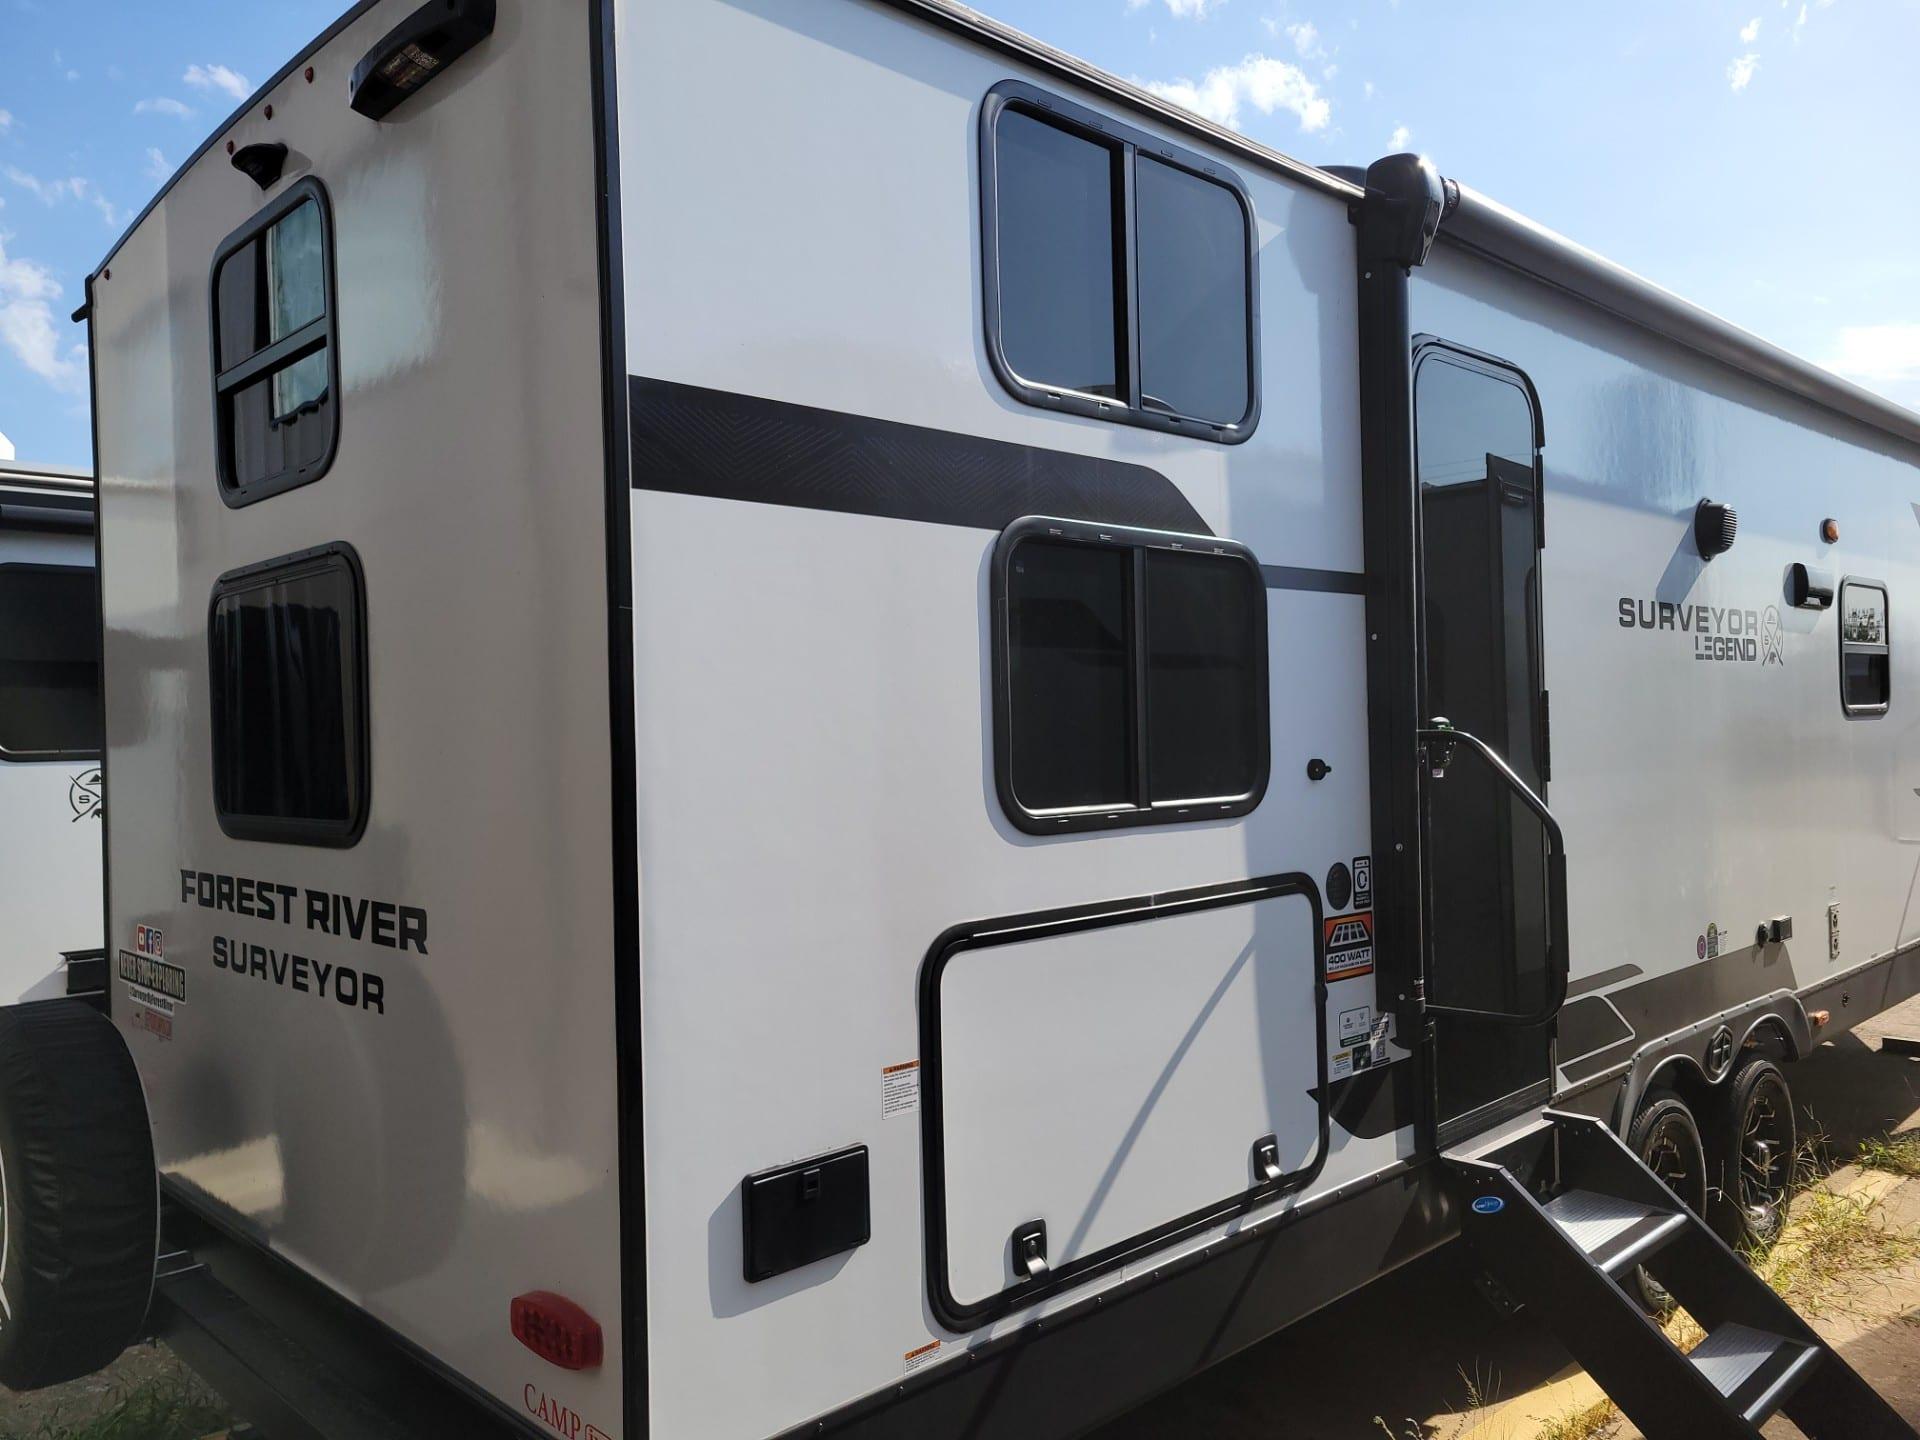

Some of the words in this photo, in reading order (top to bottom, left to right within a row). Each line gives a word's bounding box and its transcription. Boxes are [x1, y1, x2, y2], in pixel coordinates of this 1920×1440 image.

[1618, 597, 1758, 636] SURVEYOR
[1695, 635, 1757, 662] LEGEND
[78, 794, 91, 805] S
[180, 869, 297, 924] FOREST
[304, 888, 429, 955] RIVER
[212, 935, 384, 1015] SURVEYOR
[1328, 953, 1346, 965] 400
[1347, 948, 1371, 961] WATT
[524, 1383, 581, 1440] CAMP
